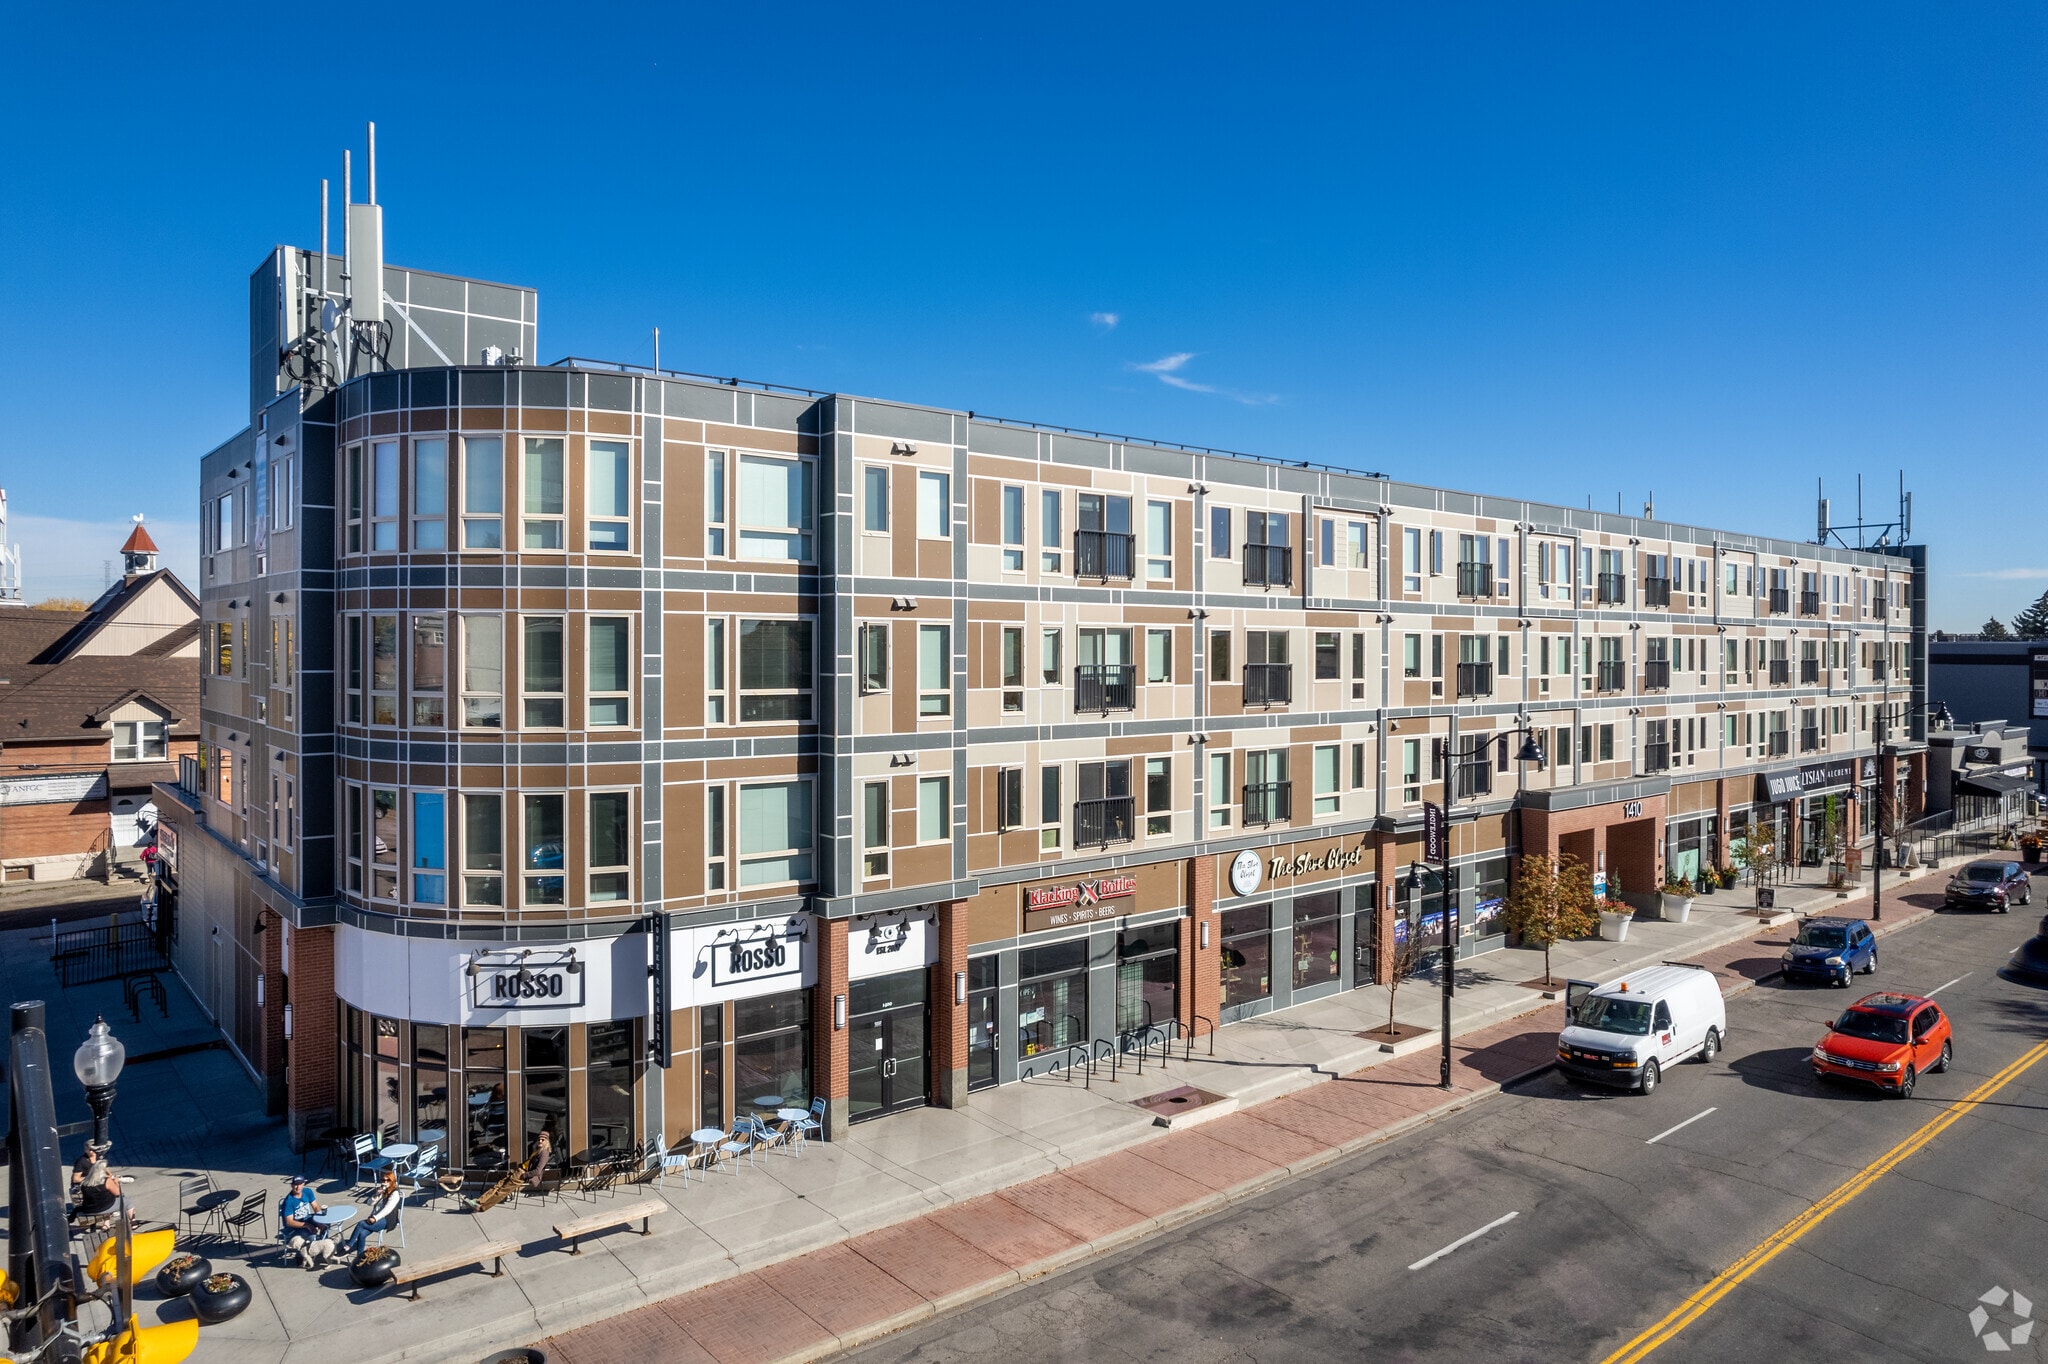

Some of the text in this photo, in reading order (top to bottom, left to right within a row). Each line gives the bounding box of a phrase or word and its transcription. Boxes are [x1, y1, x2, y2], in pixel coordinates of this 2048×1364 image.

[1799, 768, 1826, 786] LYSIAN
[1625, 801, 1642, 818] 1410
[1271, 846, 1361, 879] The Shoe Closet
[1029, 876, 1136, 905] Klacking Bottles
[1050, 905, 1116, 925] WINES SPIRITS BEERS
[730, 944, 785, 974] ROSSO
[495, 973, 563, 998] ROSSO
